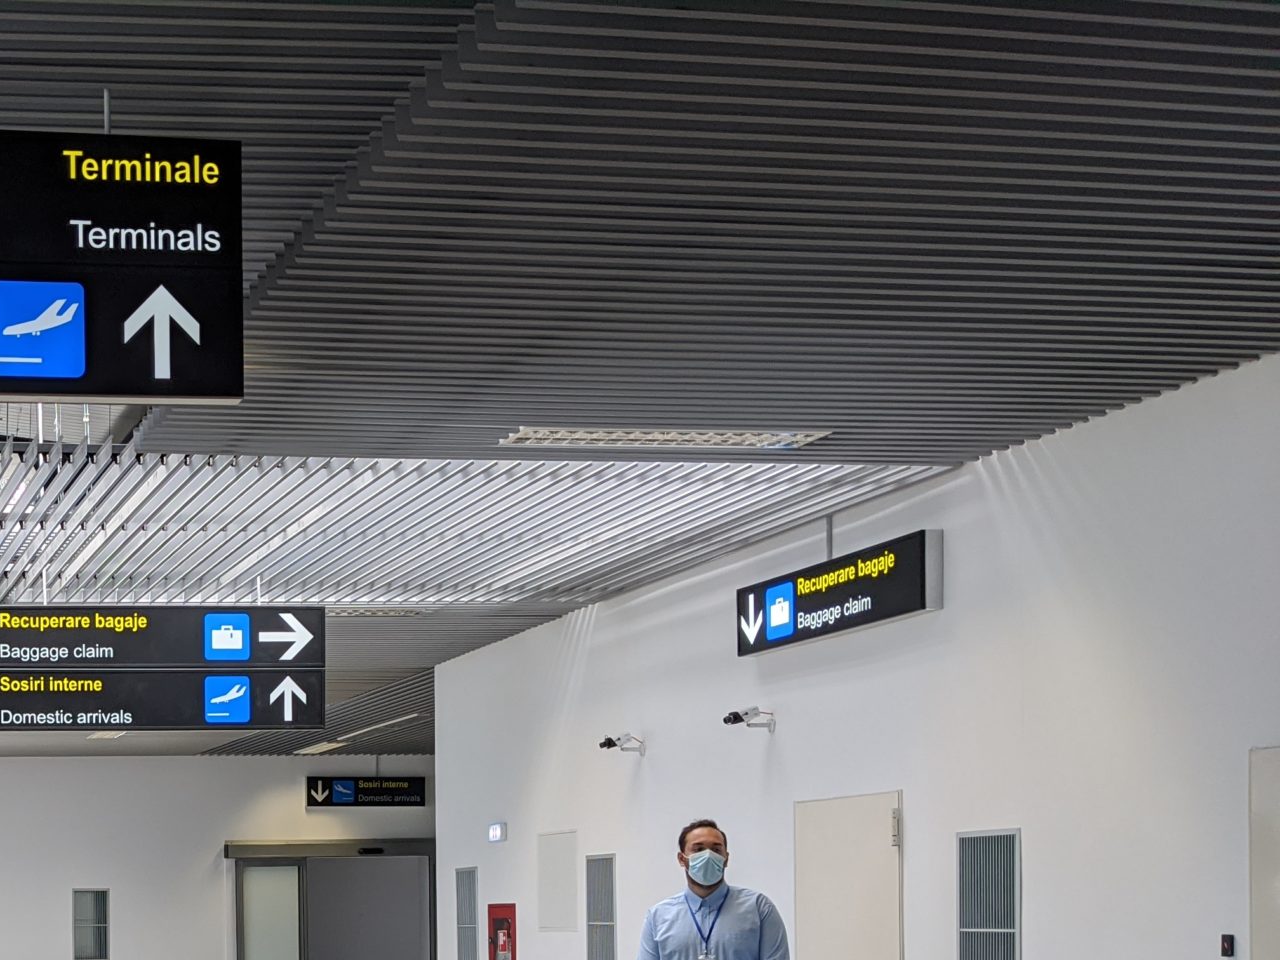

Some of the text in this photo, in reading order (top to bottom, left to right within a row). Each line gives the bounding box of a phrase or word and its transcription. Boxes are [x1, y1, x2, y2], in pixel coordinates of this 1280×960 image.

[62, 150, 220, 185] Terminale
[69, 219, 221, 252] Terminals
[797, 550, 895, 596] Recuperare bagaje
[0, 612, 148, 632] Recuperare bagaje
[797, 595, 872, 630] Baggage claim
[0, 643, 114, 662] Baggage claim
[0, 676, 103, 692] Sosiri interne
[0, 709, 133, 725] Domestic arrivals
[358, 779, 409, 789] Sosiri interne
[357, 793, 421, 802] Domestic arrivals
